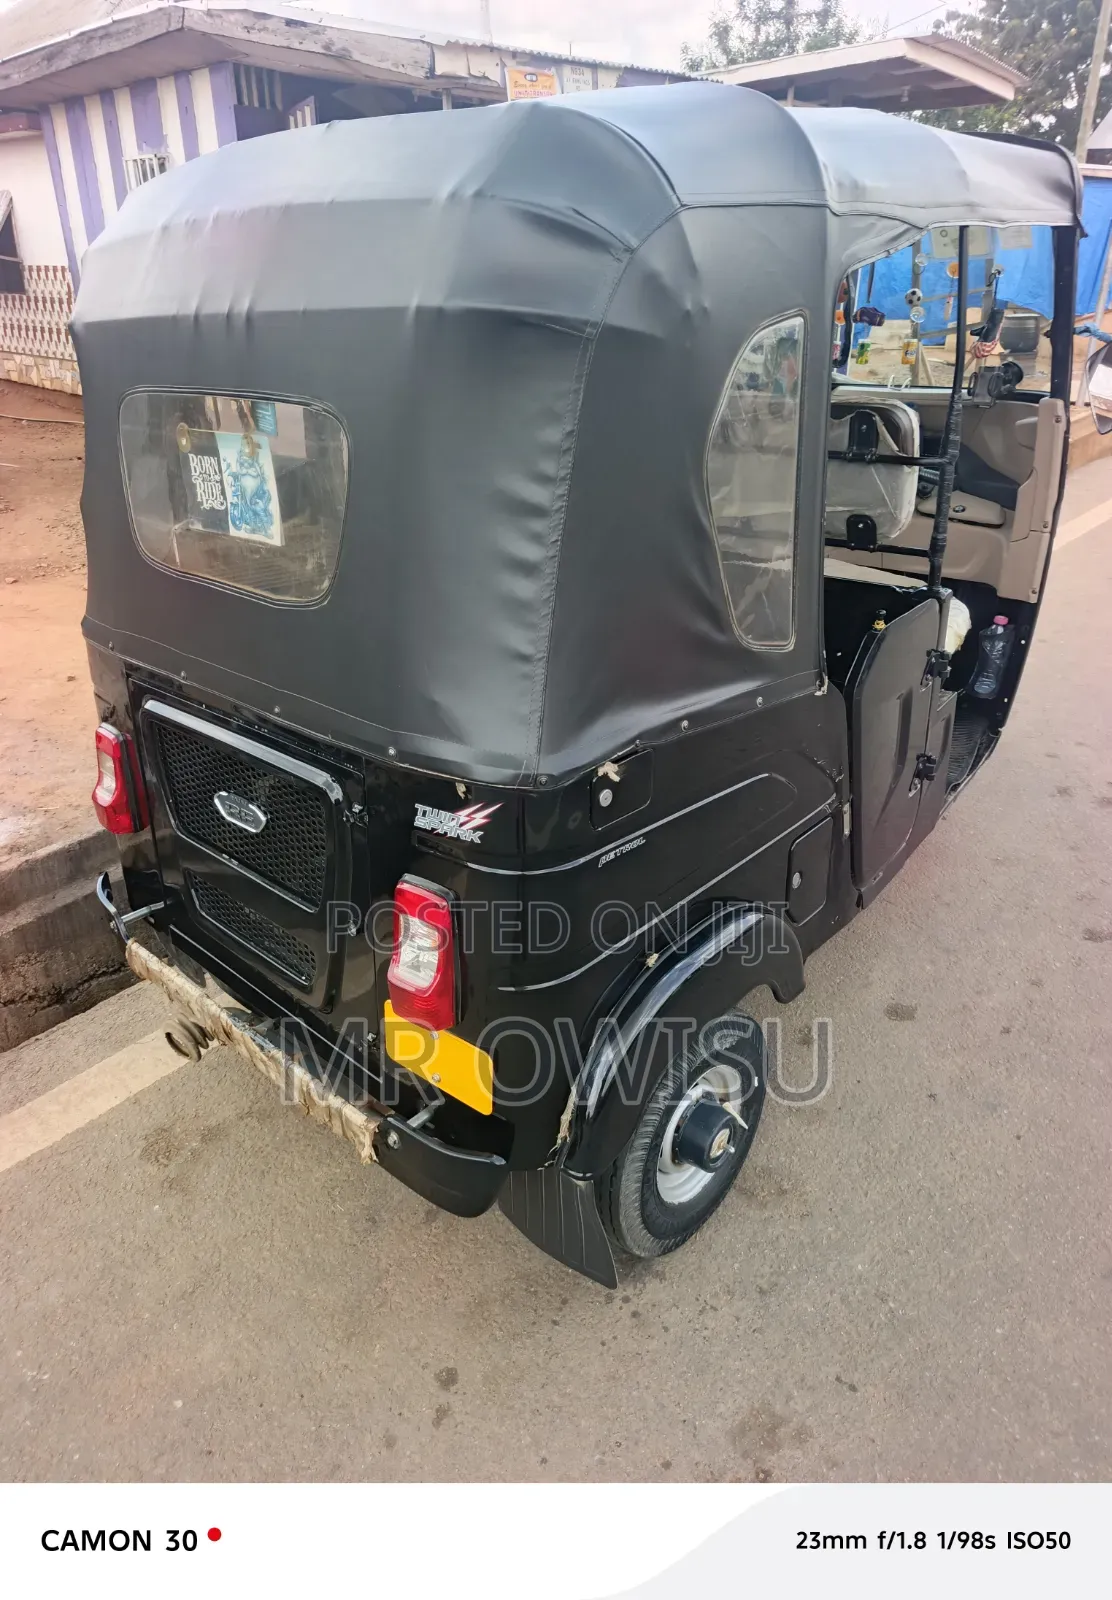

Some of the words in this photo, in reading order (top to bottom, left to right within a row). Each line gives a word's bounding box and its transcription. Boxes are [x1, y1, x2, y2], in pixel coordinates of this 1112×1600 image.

[188, 453, 220, 478] BORN
[192, 476, 226, 510] RIDE
[414, 815, 484, 844] SPARK
[598, 836, 646, 868] PETROL
